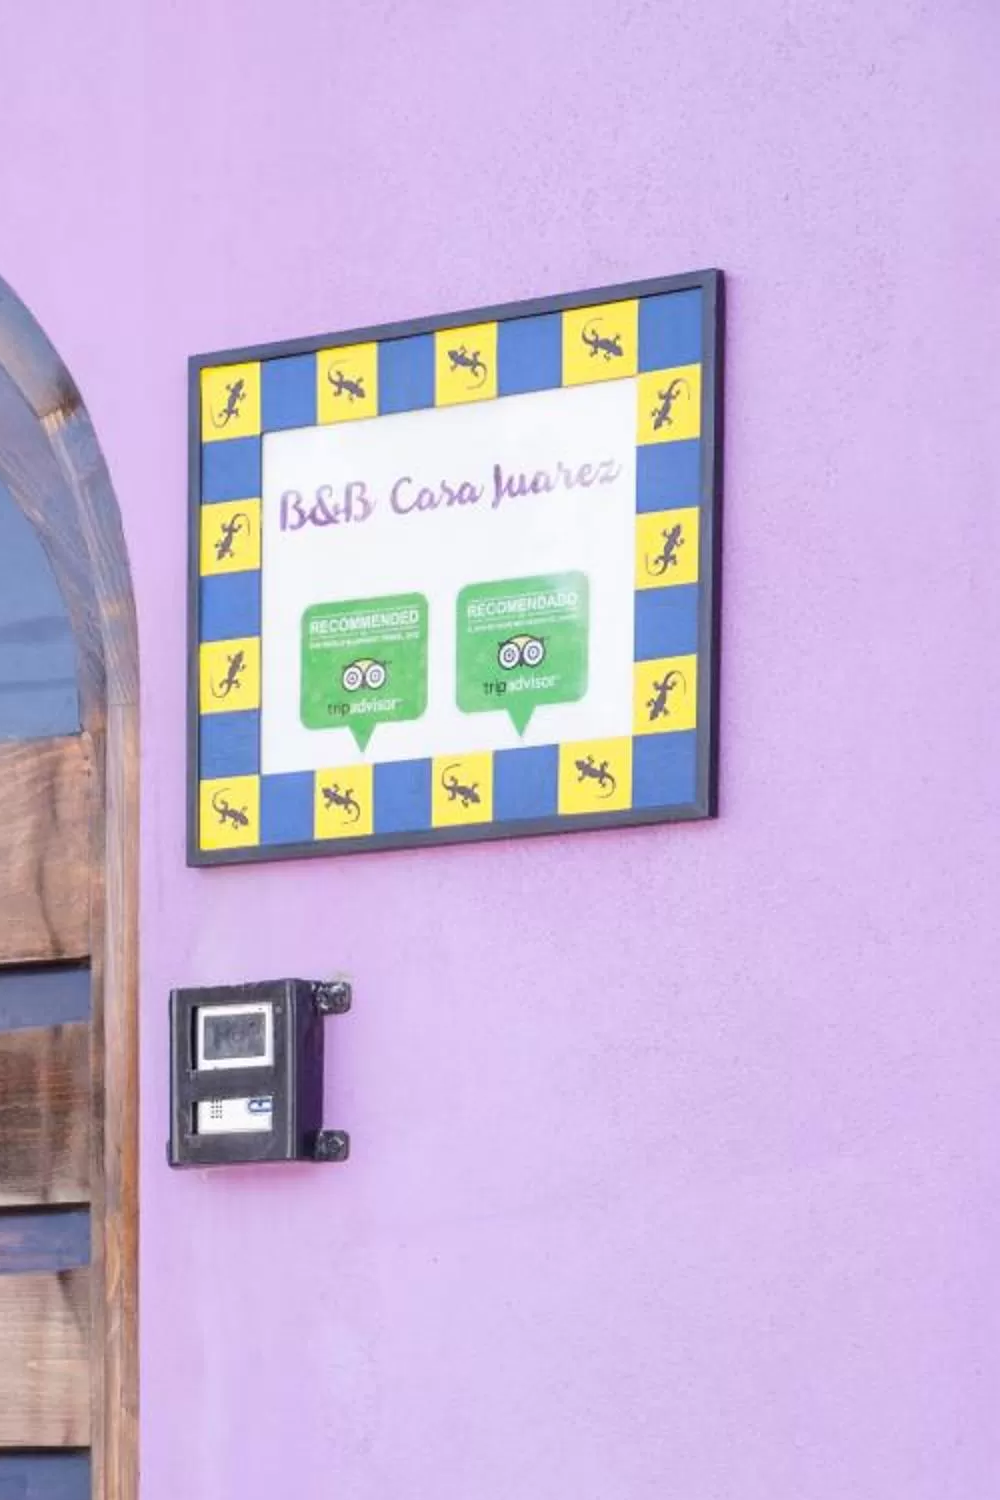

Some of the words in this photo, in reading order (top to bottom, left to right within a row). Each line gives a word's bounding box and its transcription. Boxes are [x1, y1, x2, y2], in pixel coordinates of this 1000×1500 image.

[279, 480, 375, 532] B&B
[389, 475, 485, 515] Casa
[491, 457, 624, 509] Juarez
[466, 592, 578, 618] RECOMENDADO
[310, 609, 419, 633] RECOMMENDED
[482, 674, 556, 696] tripadvisor
[327, 697, 400, 717] tripadvisor
